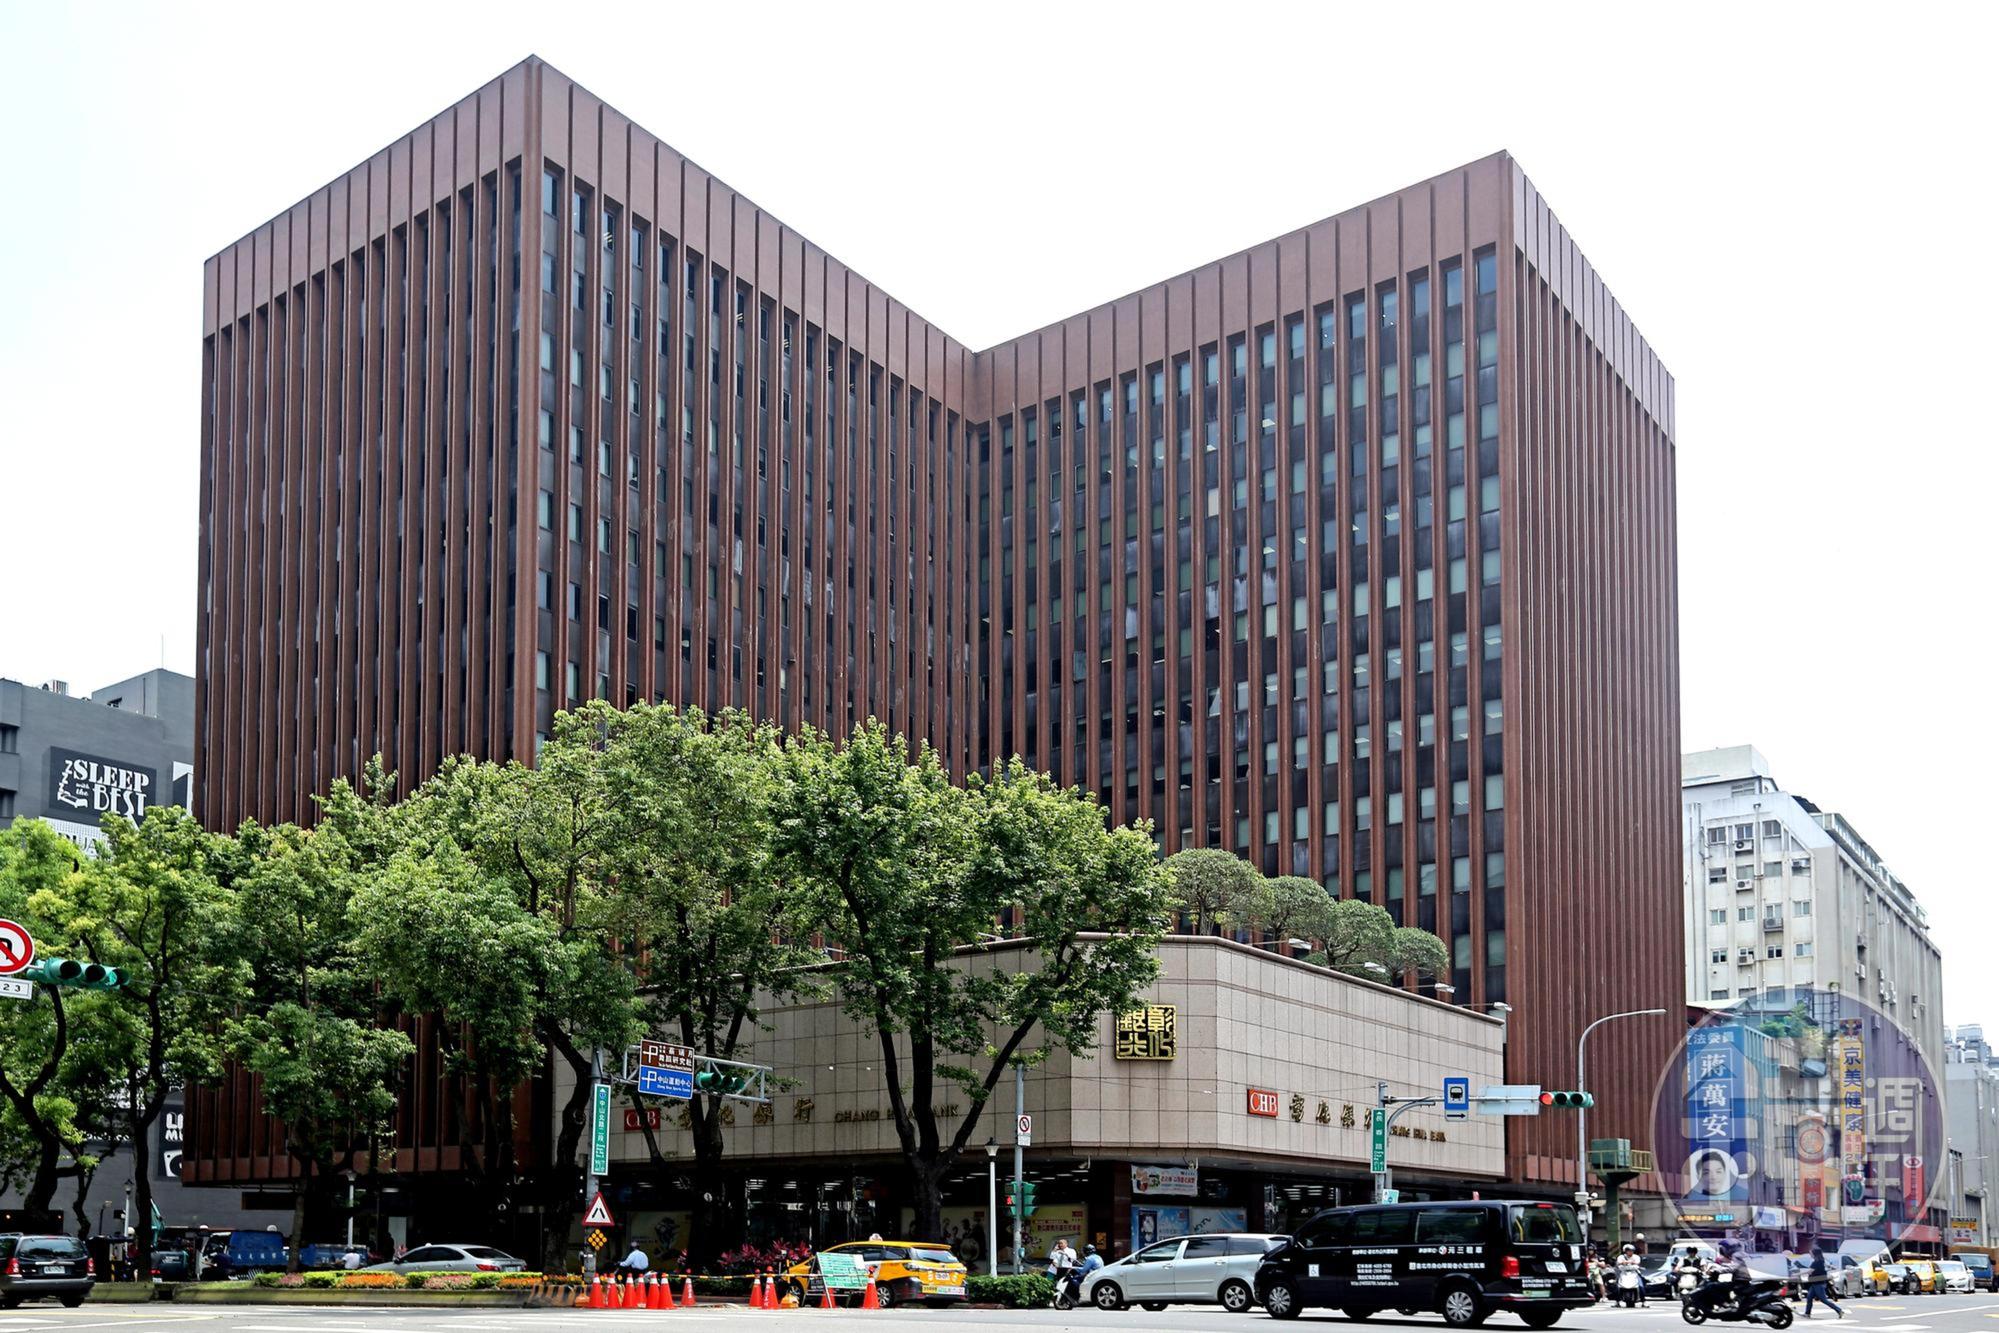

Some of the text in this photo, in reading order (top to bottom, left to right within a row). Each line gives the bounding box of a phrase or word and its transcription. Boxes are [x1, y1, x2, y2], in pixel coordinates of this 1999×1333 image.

[73, 759, 149, 793] SLEEP
[76, 788, 89, 797] the
[93, 783, 147, 817] BEST
[1250, 1092, 1278, 1113] CHB
[1700, 1053, 1728, 1138] 蔣萬安
[626, 1111, 656, 1128] CB
[835, 1109, 879, 1122] CHANG
